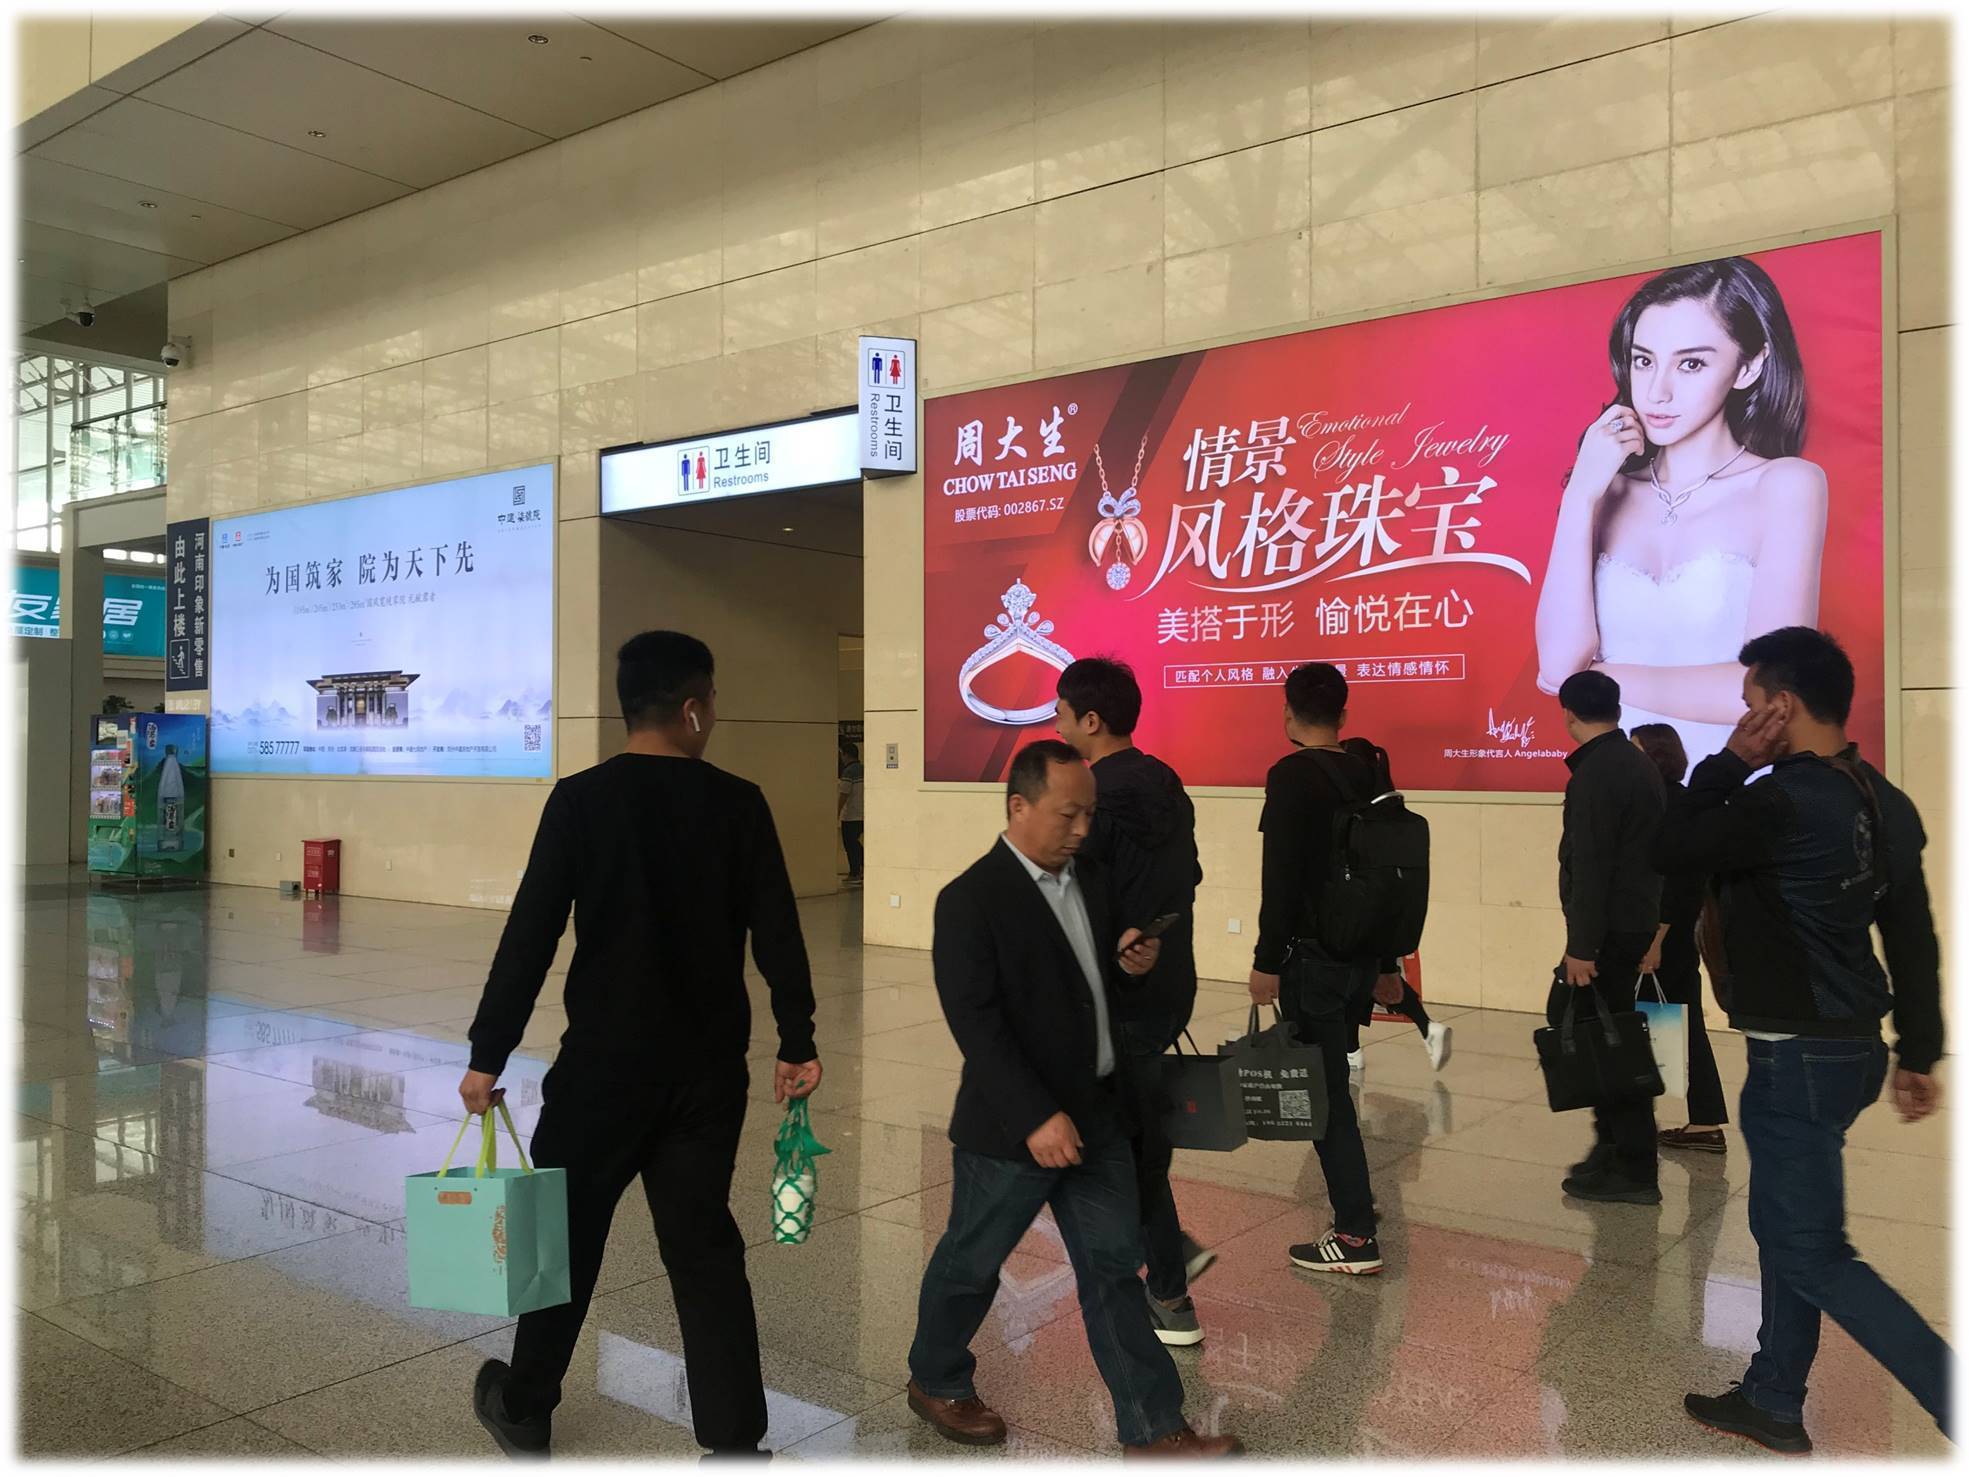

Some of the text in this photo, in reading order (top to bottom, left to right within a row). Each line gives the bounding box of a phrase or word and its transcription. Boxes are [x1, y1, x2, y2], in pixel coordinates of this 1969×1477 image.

[869, 392, 881, 458] Restrooms
[884, 393, 904, 461] 卫生间
[953, 405, 1066, 467] 周大生
[1297, 402, 1411, 440] Emotional
[713, 440, 771, 471] 卫生间
[713, 472, 770, 489] Restrooms
[943, 462, 1078, 496] CHOW TAI SENG
[1183, 416, 1296, 492] 情景
[1313, 420, 1511, 485] Style Jewelry
[954, 497, 1065, 523] 股票代码: 002867.SZ
[1135, 466, 1512, 592] 风格珠宝
[173, 535, 187, 638] 由此上楼
[265, 540, 475, 596] 为国筑家 院为天下先
[193, 532, 206, 678] 河南印象新零售
[1156, 588, 1475, 645] 美搭于形 愉悦在心
[1175, 667, 1254, 683] 匹配个人风格
[1356, 660, 1450, 678] 表达情感情怀
[259, 740, 274, 755] 585
[275, 740, 300, 755] 77777
[1443, 748, 1568, 760] 周大生形象代言人 Angelababy
